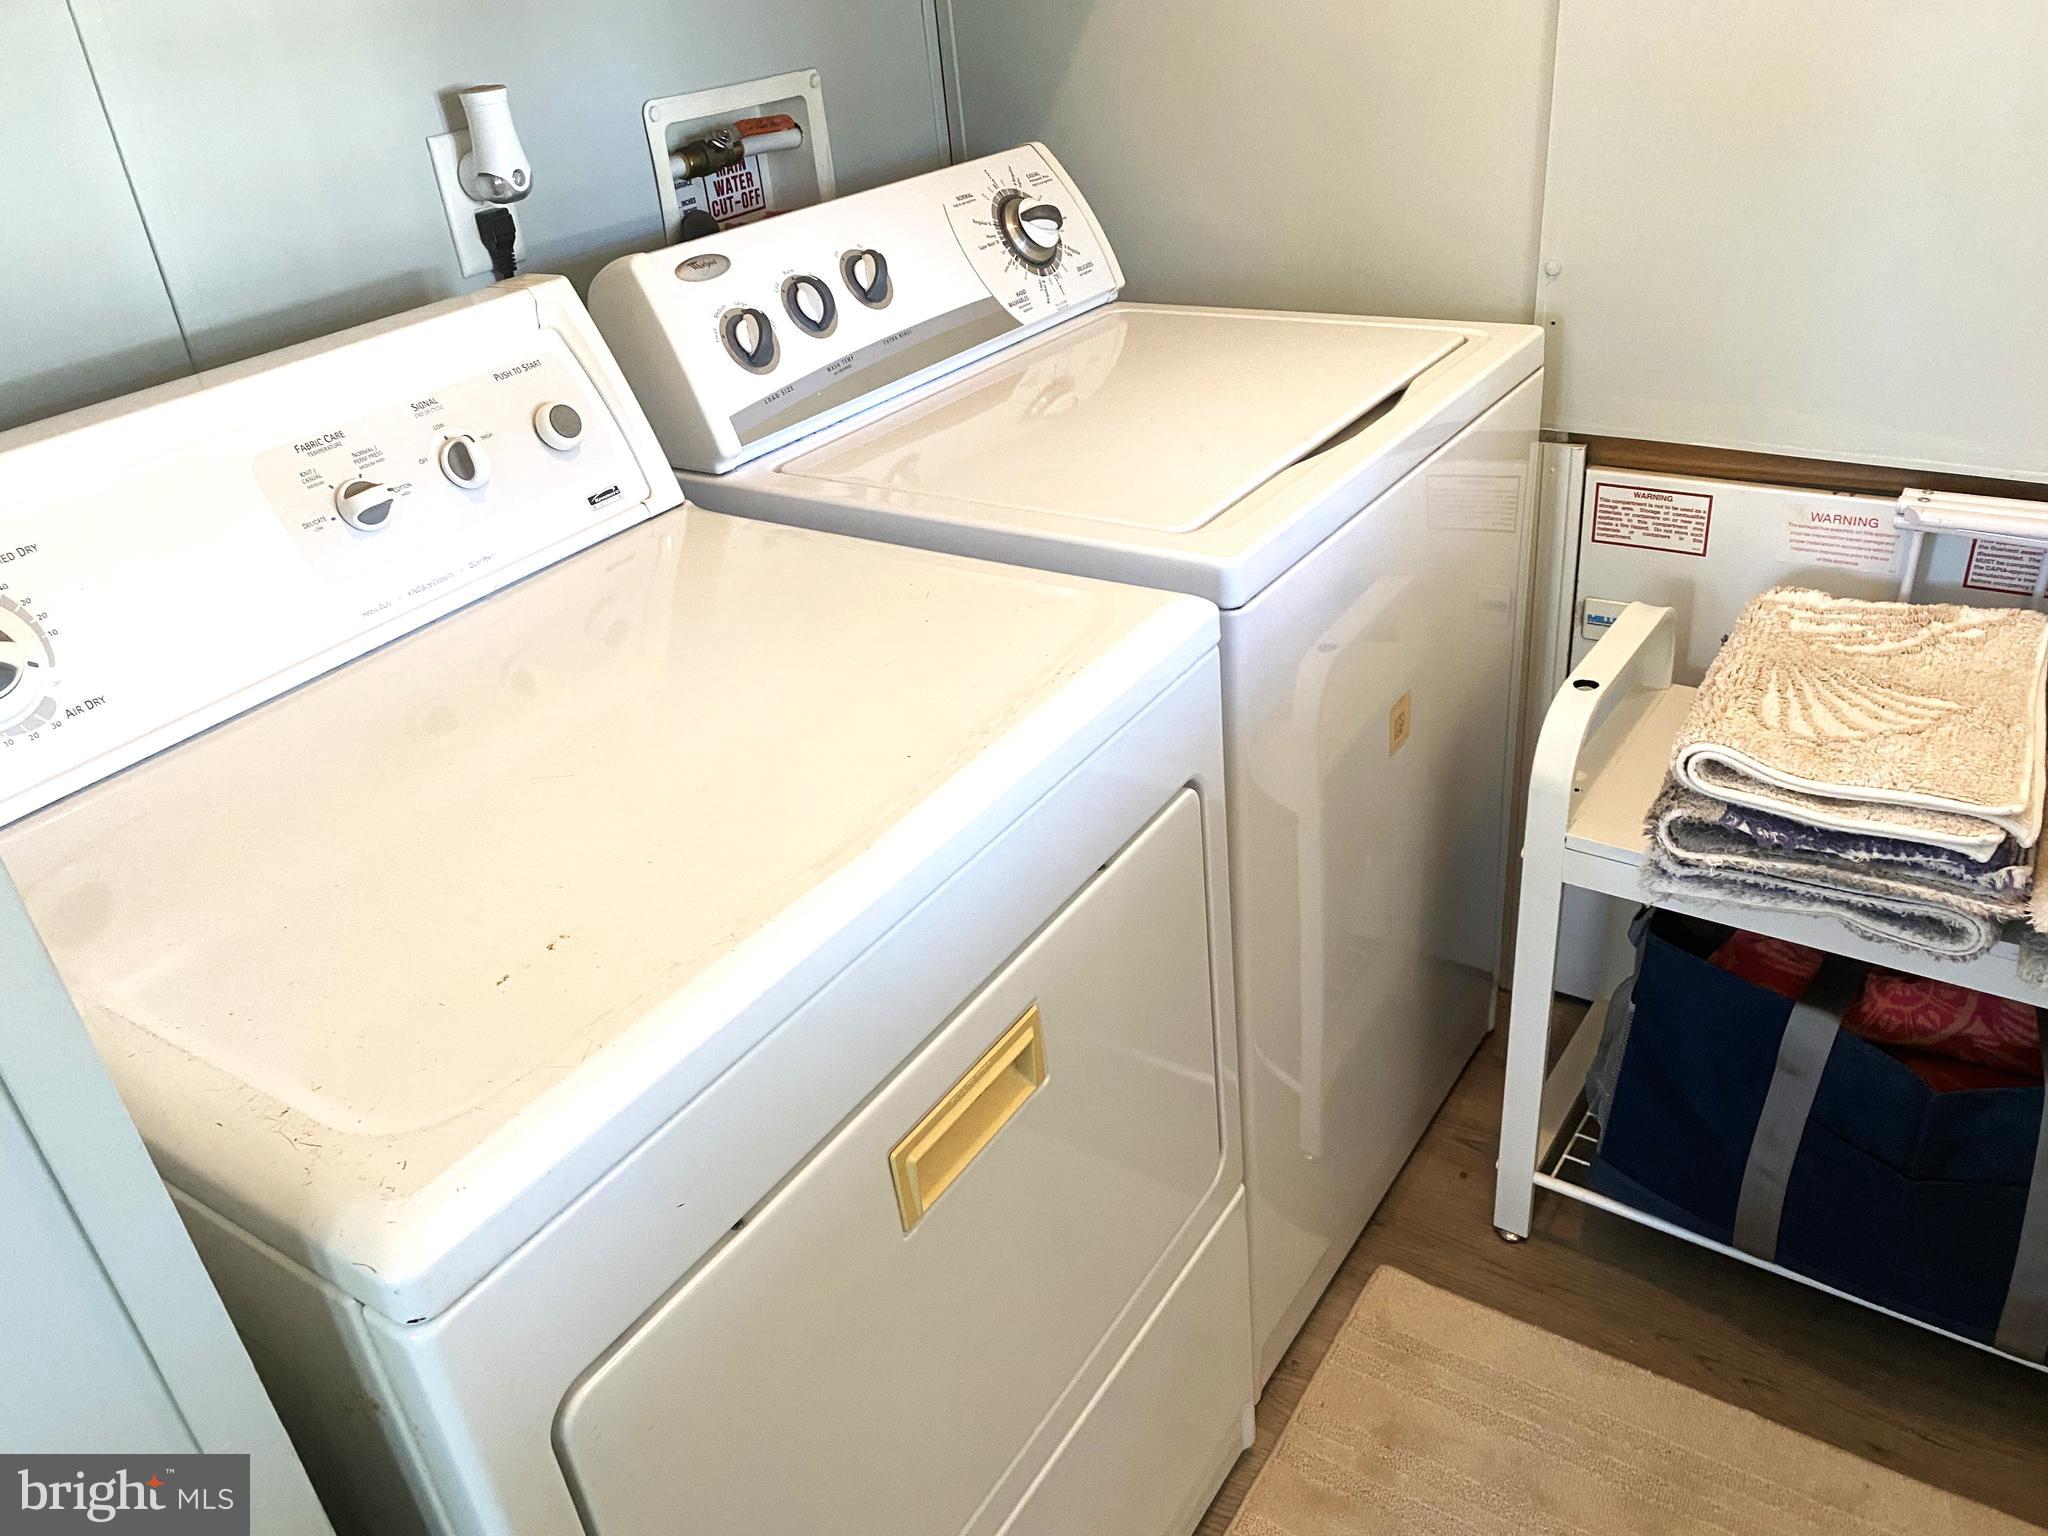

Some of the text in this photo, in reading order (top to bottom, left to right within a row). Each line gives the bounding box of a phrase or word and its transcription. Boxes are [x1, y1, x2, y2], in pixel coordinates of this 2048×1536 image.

[713, 172, 754, 197] WATER
[712, 188, 760, 218] CUT-OFF
[686, 260, 718, 270] Whirlpool
[493, 370, 513, 381] PUSH
[521, 360, 541, 371] START
[827, 362, 840, 372] WASH
[842, 356, 854, 365] TEMP
[764, 386, 794, 405] LOAD SIZE
[411, 398, 438, 411] SIGNAL
[294, 430, 345, 454] FABRIC CARE
[307, 441, 343, 457] TEMPERATURE
[1634, 491, 1673, 502] WARNING
[1612, 499, 1647, 508] compartment
[302, 516, 327, 529] DELICATE
[1673, 512, 1705, 520] combustible
[1811, 512, 1879, 528] WARNING
[1652, 521, 1688, 530] compartment
[16, 543, 38, 558] DRY
[20, 597, 32, 607] 30
[36, 612, 48, 621] 20
[48, 629, 59, 638] 10
[65, 695, 106, 719] AIR DRY
[51, 720, 62, 730] 30
[29, 731, 40, 742] 20
[4, 739, 15, 748] 10
